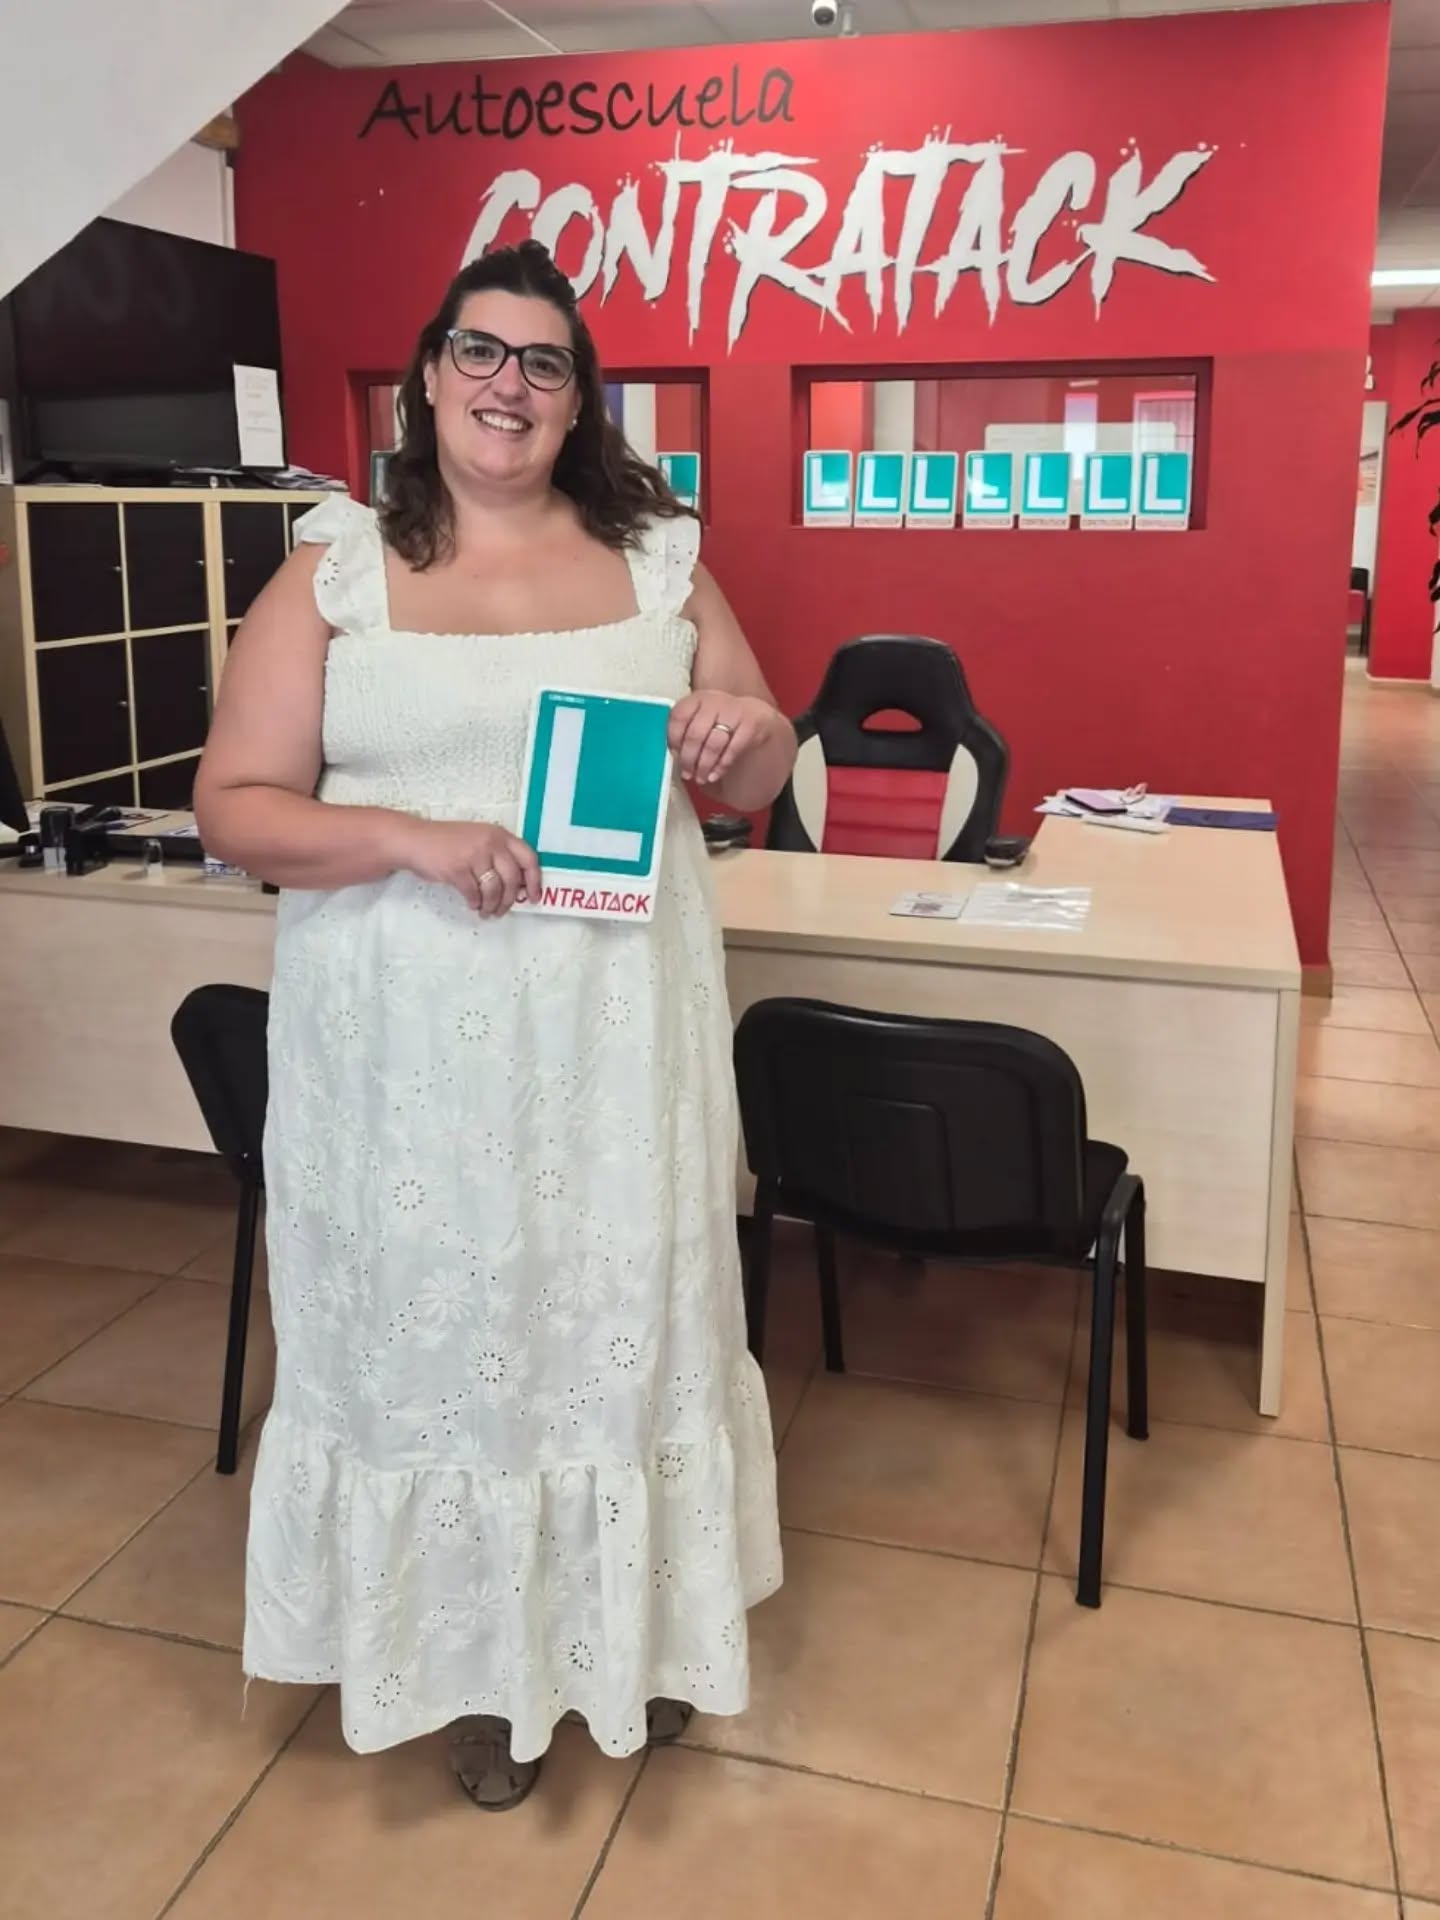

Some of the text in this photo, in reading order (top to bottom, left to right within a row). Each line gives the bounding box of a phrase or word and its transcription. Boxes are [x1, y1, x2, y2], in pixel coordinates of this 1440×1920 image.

[358, 63, 795, 140] Autoescuela
[810, 456, 848, 509] L
[861, 457, 898, 509] L
[913, 457, 950, 510] L
[1027, 456, 1065, 509] L
[1088, 457, 1127, 510] L
[1144, 456, 1183, 511] L
[537, 706, 643, 862] L
